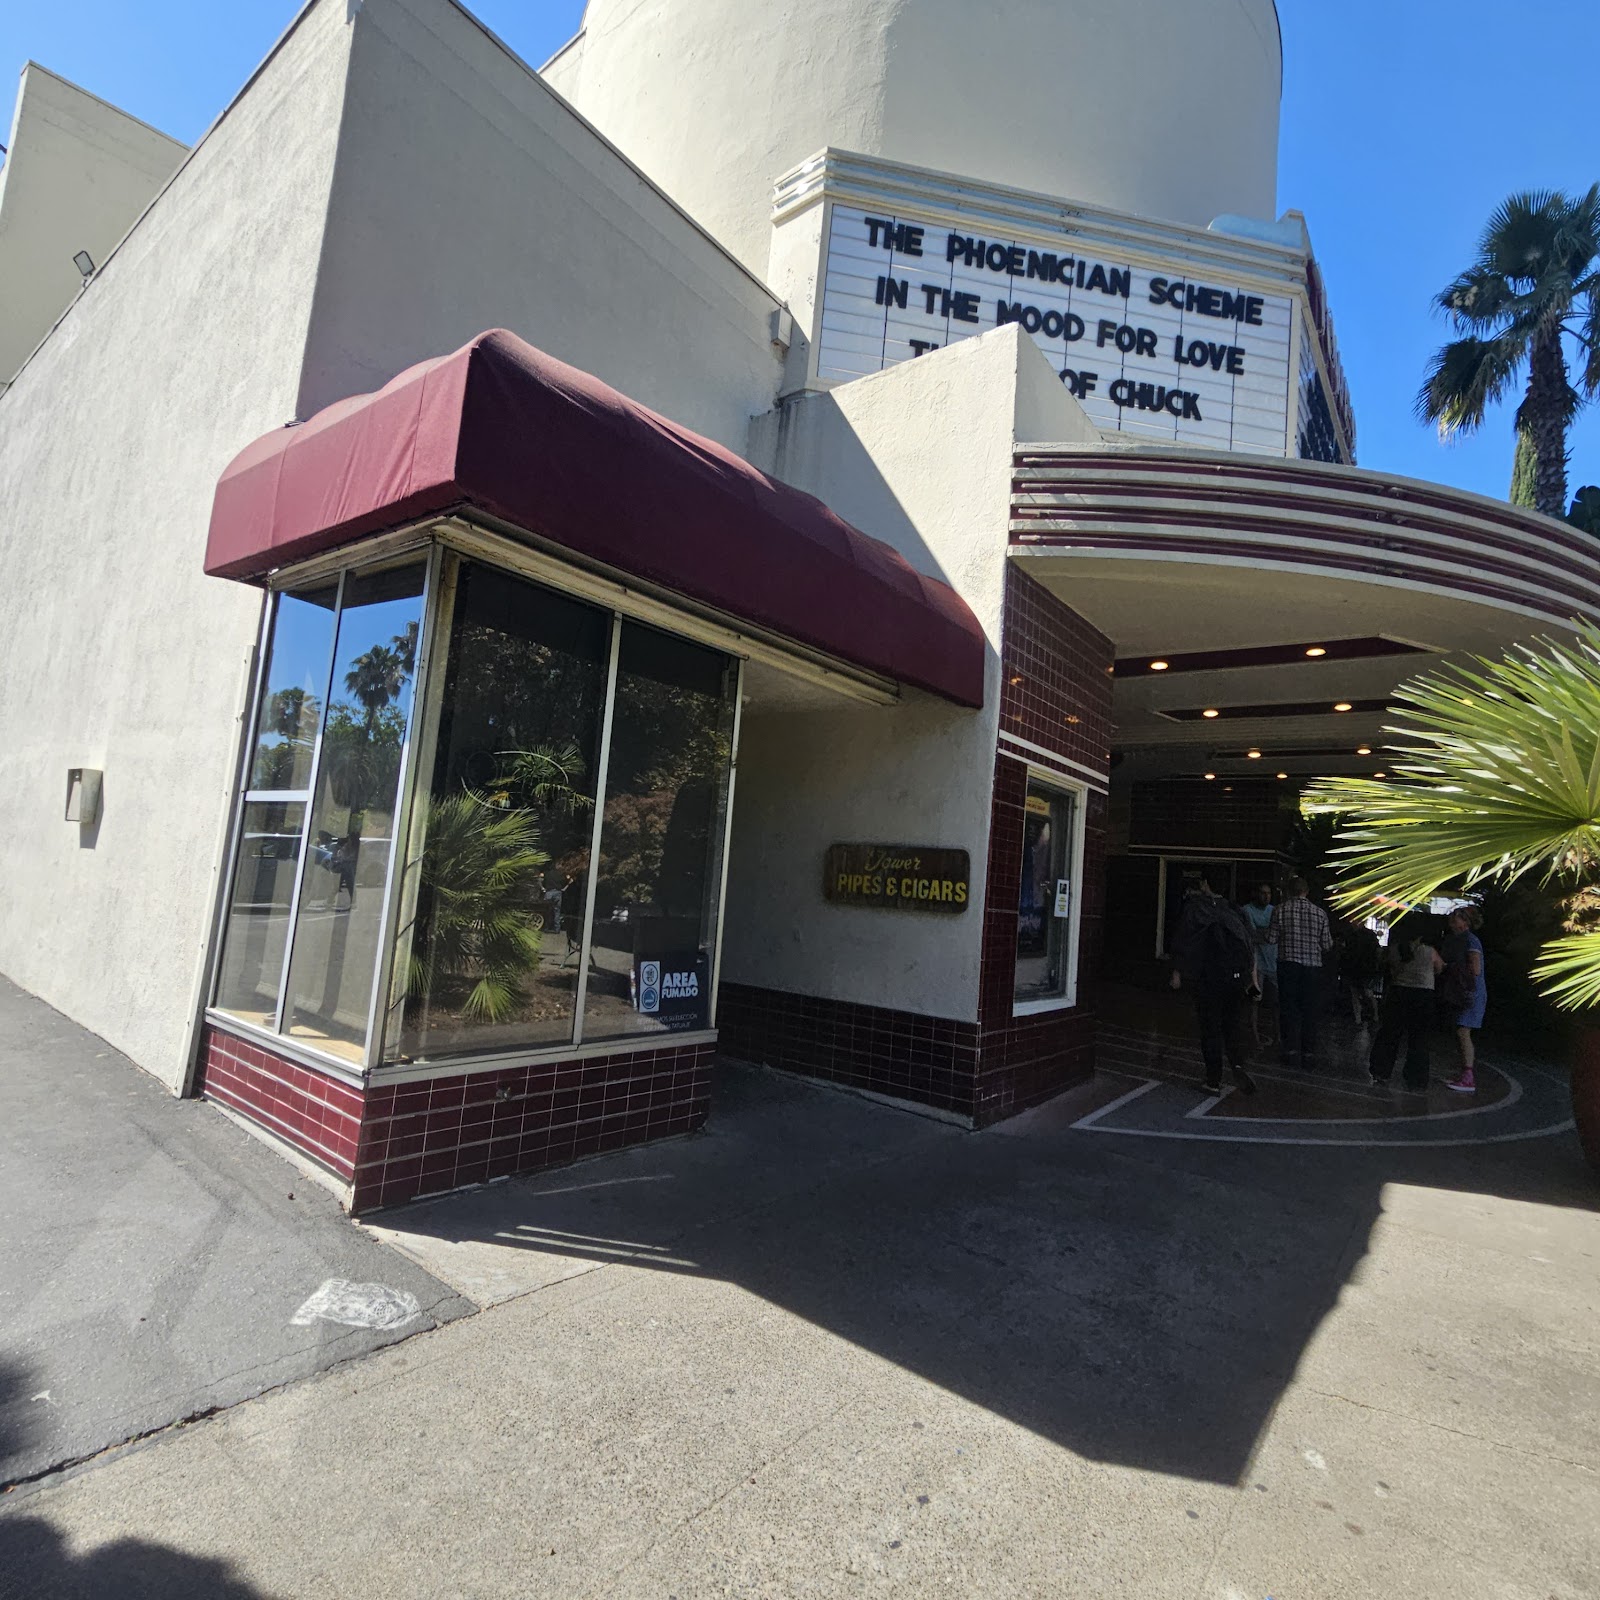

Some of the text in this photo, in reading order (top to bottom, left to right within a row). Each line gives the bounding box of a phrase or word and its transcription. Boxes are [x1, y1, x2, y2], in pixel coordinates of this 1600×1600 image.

[865, 217, 1264, 325] THE PHOENICIAN SCHEME
[875, 276, 1245, 375] IN THE MOOD FOR LOVE
[1059, 369, 1202, 421] OF CHUCK
[864, 848, 921, 871] Tower
[838, 873, 967, 902] PIPES & CIGARS
[662, 972, 699, 988] AREA
[662, 987, 699, 999] FUMADO
